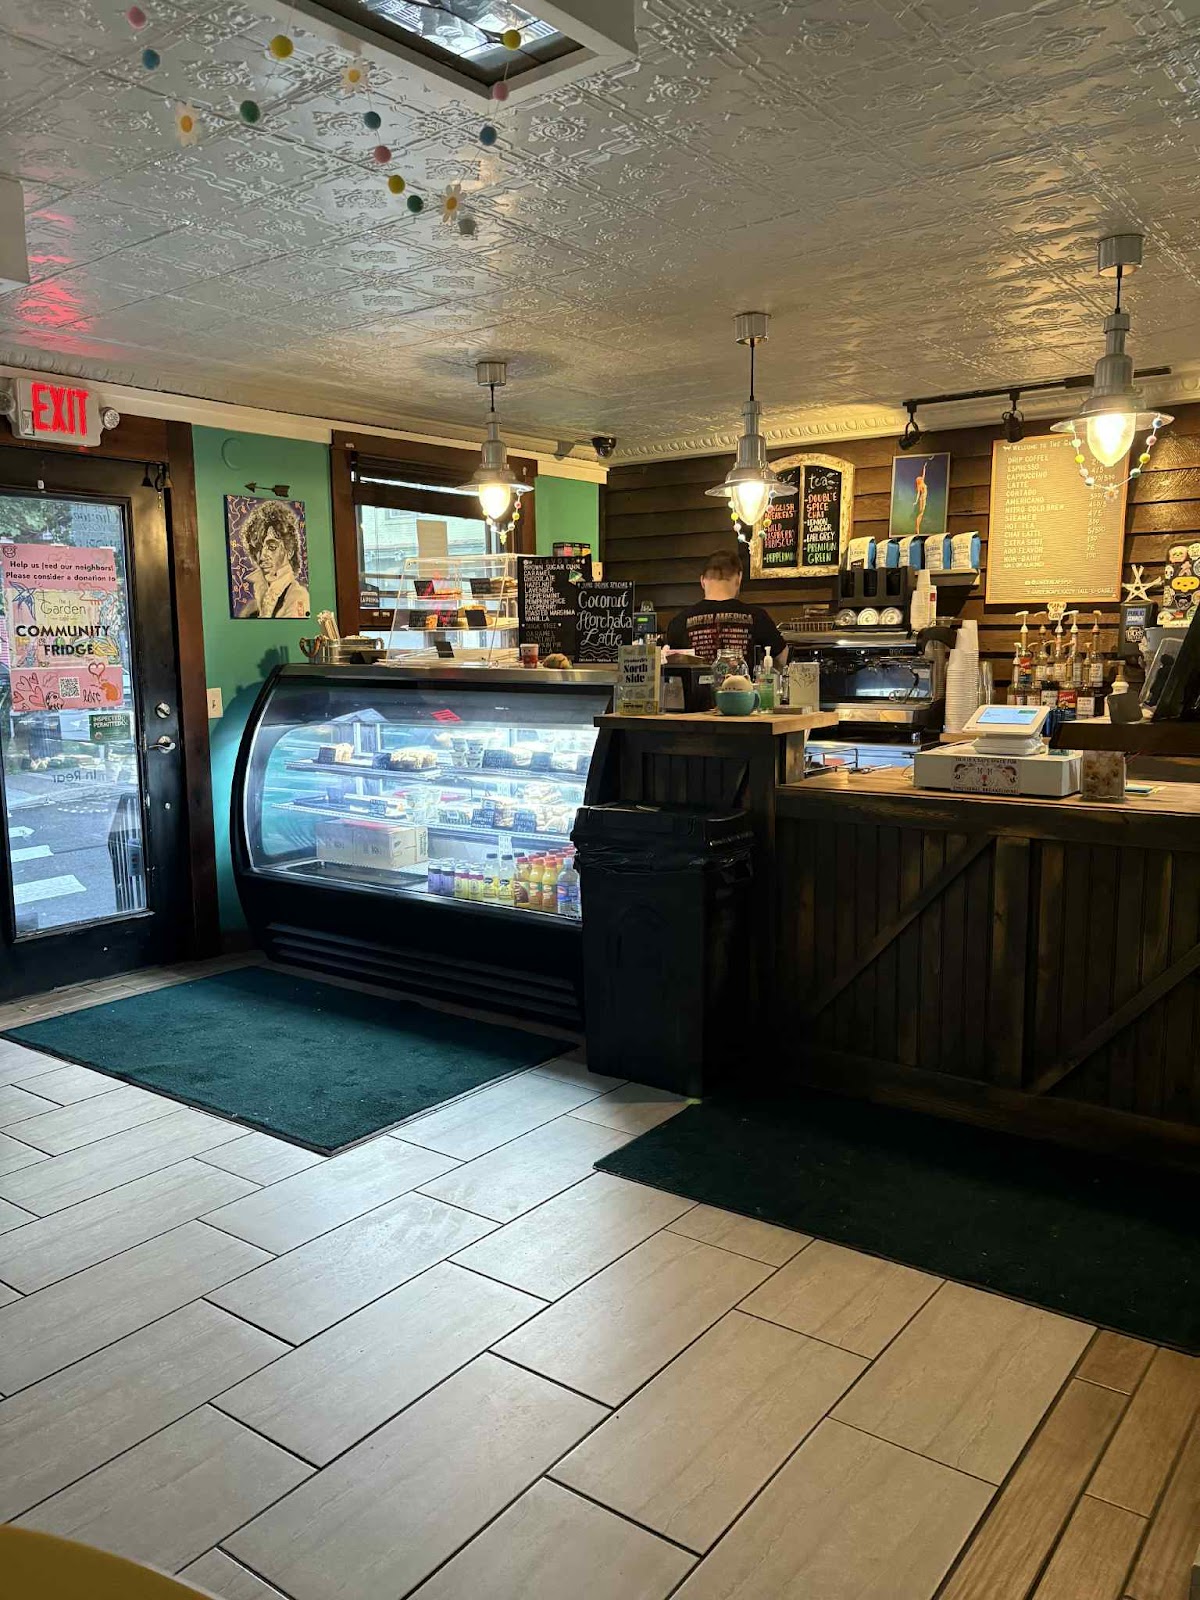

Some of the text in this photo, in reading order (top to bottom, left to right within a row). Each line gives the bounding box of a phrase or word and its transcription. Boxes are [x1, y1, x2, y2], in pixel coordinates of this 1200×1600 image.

[31, 382, 89, 437] EXIT
[1007, 454, 1049, 464] DRIP COFFEE
[1007, 463, 1040, 472] ESPRESSO
[808, 473, 828, 489] tea
[1006, 471, 1048, 481] CAPPUCCINO
[1007, 480, 1029, 489] LATTE
[1005, 489, 1037, 497] CORTADO
[1005, 497, 1045, 505] AMERICANO
[806, 502, 829, 512] SPICE
[1028, 505, 1045, 513] COLD
[807, 511, 825, 519] CHAI
[1005, 514, 1037, 522] STEAMER
[820, 531, 836, 541] GREY
[1021, 530, 1043, 538] LATTE
[1003, 539, 1025, 547] EXTRA
[1025, 538, 1043, 547] SHOT
[1018, 546, 1044, 554] FLAVOR
[807, 552, 832, 564] GREEN
[10, 560, 28, 570] Help
[41, 562, 58, 570] feed
[75, 563, 114, 572] neighbors!
[5, 571, 31, 580] Please
[33, 573, 65, 581] consider
[74, 574, 107, 582] donation
[550, 597, 566, 605] SPICE
[578, 590, 629, 609] Coconut
[40, 600, 87, 615] Garden
[576, 609, 633, 631] Horchata
[15, 625, 110, 637] COMMUNITY
[580, 628, 623, 647] Latte
[44, 644, 94, 656] FRIDGE
[623, 663, 648, 673] North
[625, 673, 645, 683] Side
[82, 689, 101, 703] love
